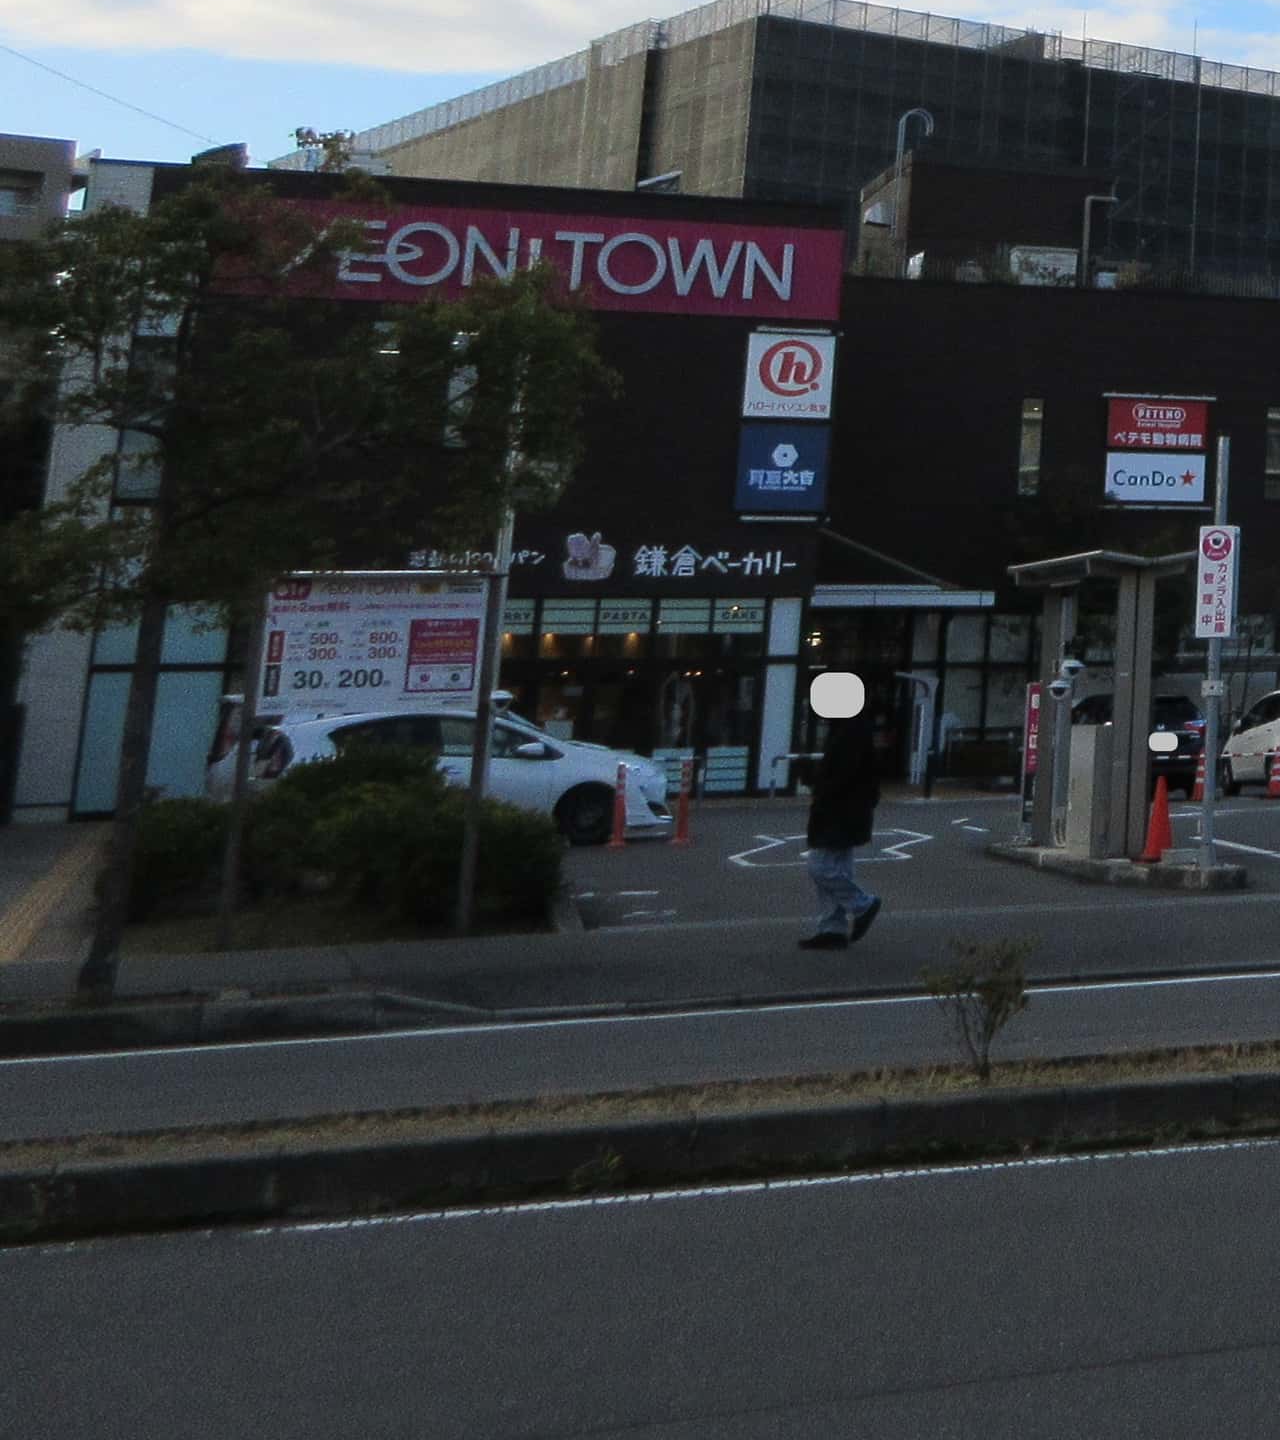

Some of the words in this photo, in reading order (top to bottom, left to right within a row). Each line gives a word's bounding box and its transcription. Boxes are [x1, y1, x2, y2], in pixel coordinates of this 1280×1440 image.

[556, 231, 795, 301] TOWN
[1113, 431, 1203, 447] ペテモ動物病院
[1112, 469, 1178, 487] CanDo
[633, 543, 797, 577] 鎌倉ベーカリー
